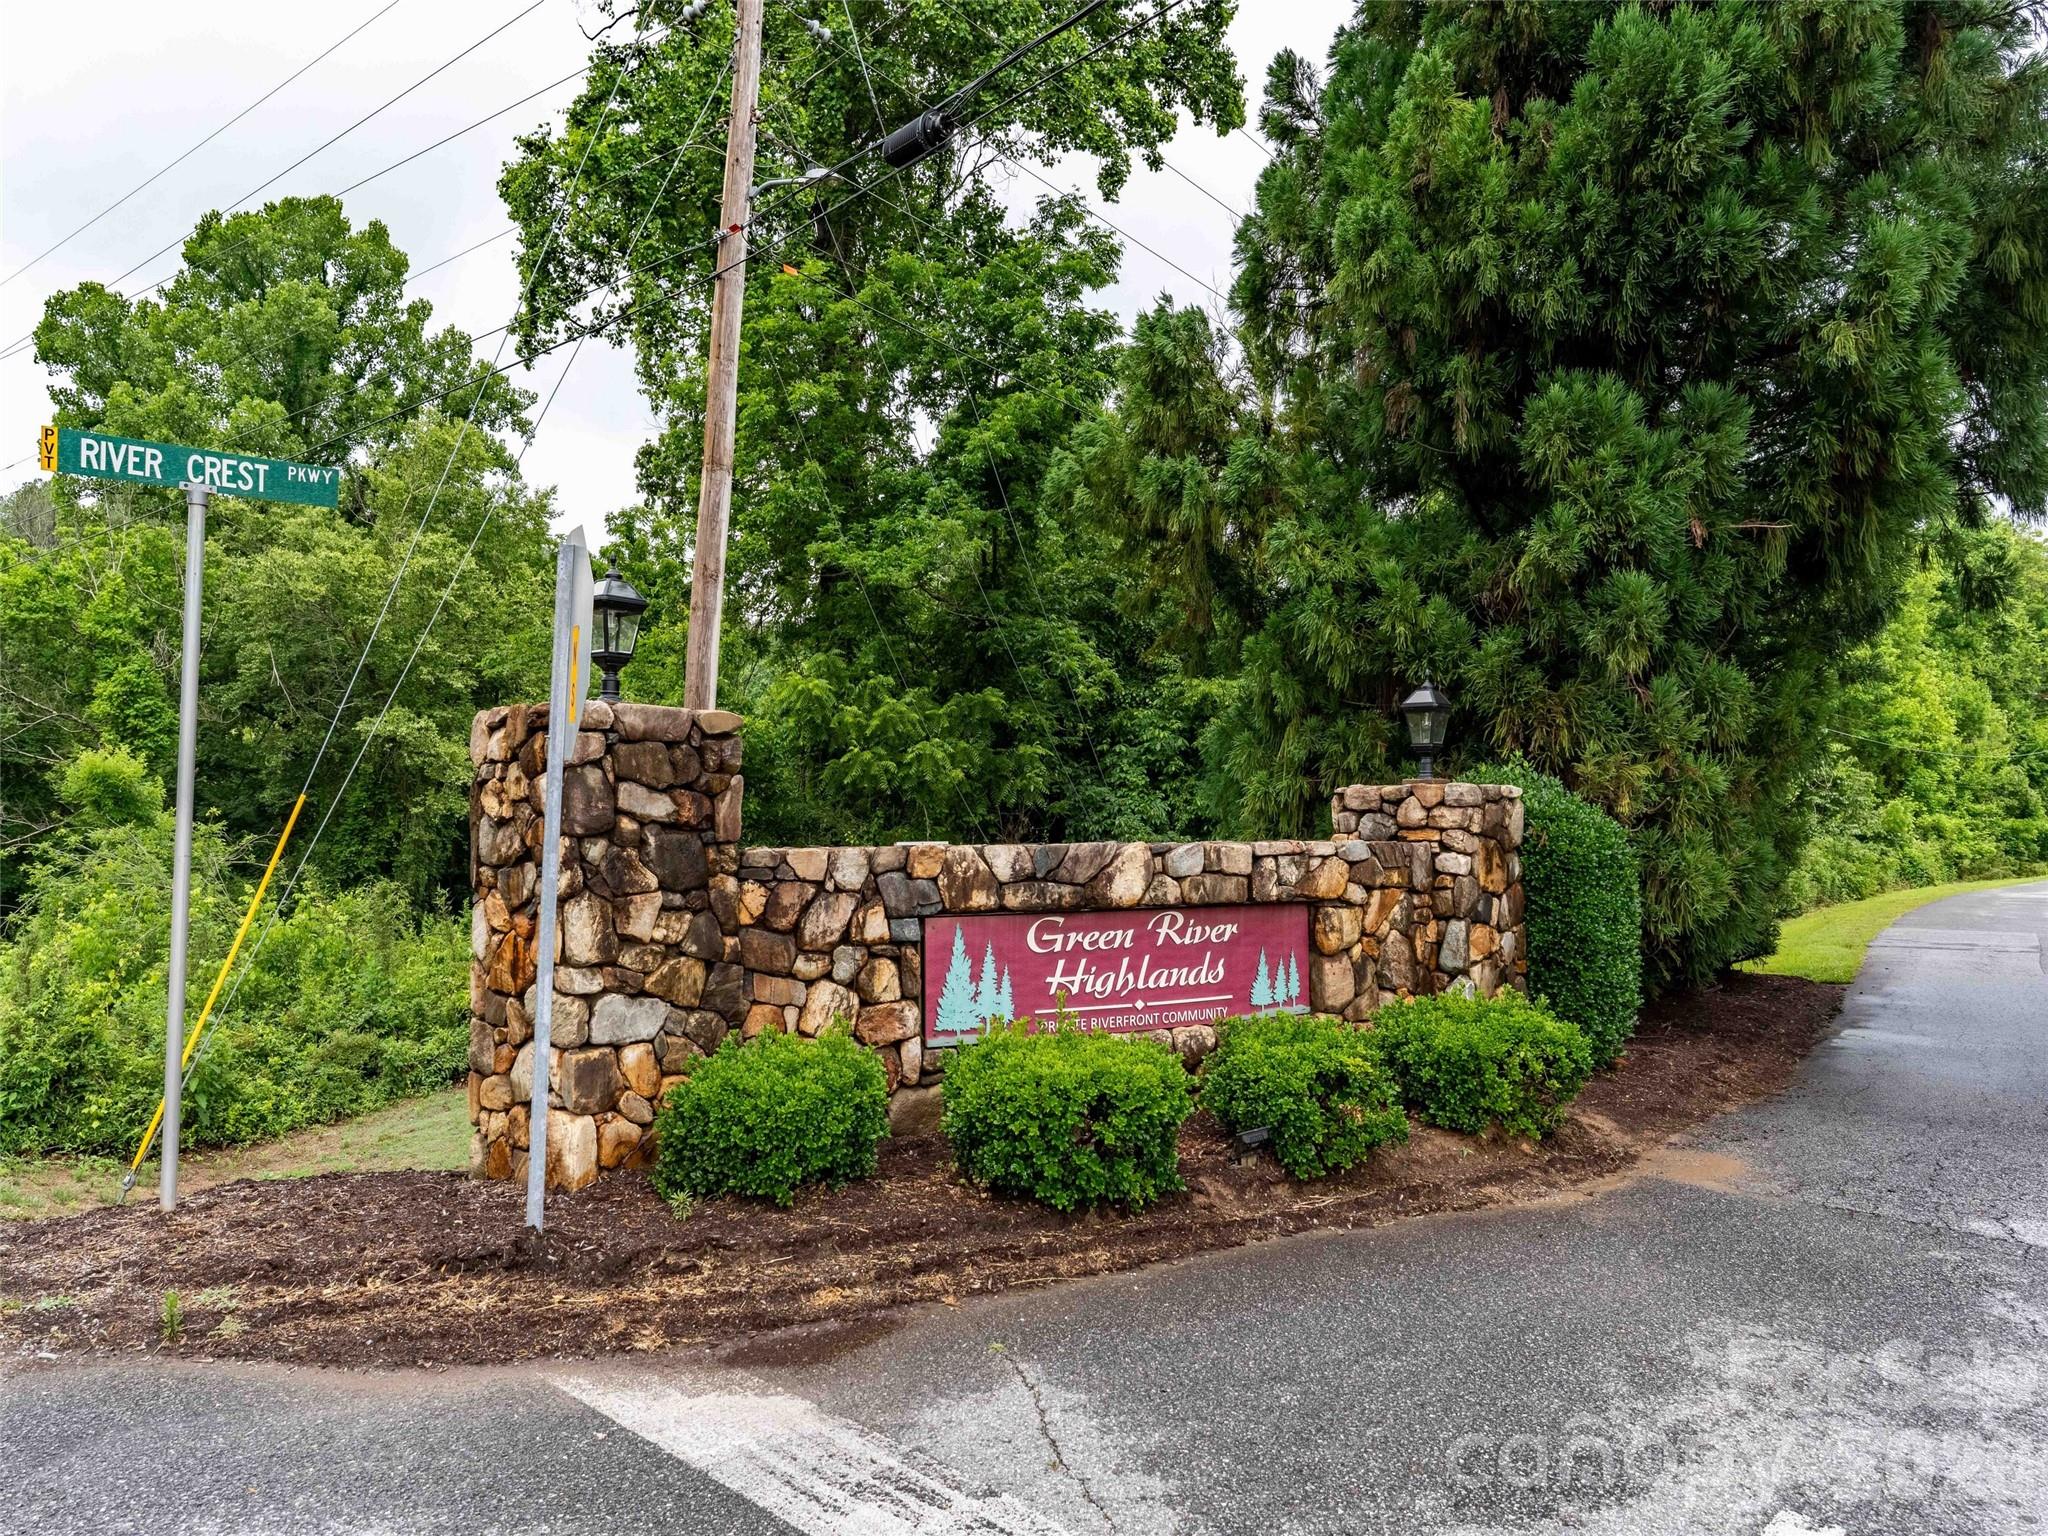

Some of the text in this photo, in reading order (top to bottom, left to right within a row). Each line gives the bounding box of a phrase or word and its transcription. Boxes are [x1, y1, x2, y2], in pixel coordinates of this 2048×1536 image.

[44, 428, 55, 469] PVT
[80, 437, 333, 493] RIVER CREST PKWY
[1026, 911, 1239, 954] Green River
[1045, 950, 1225, 999] Highlands
[1090, 1013, 1160, 1029] RIVERFRONT
[1162, 1006, 1228, 1024] COMMUNITY
